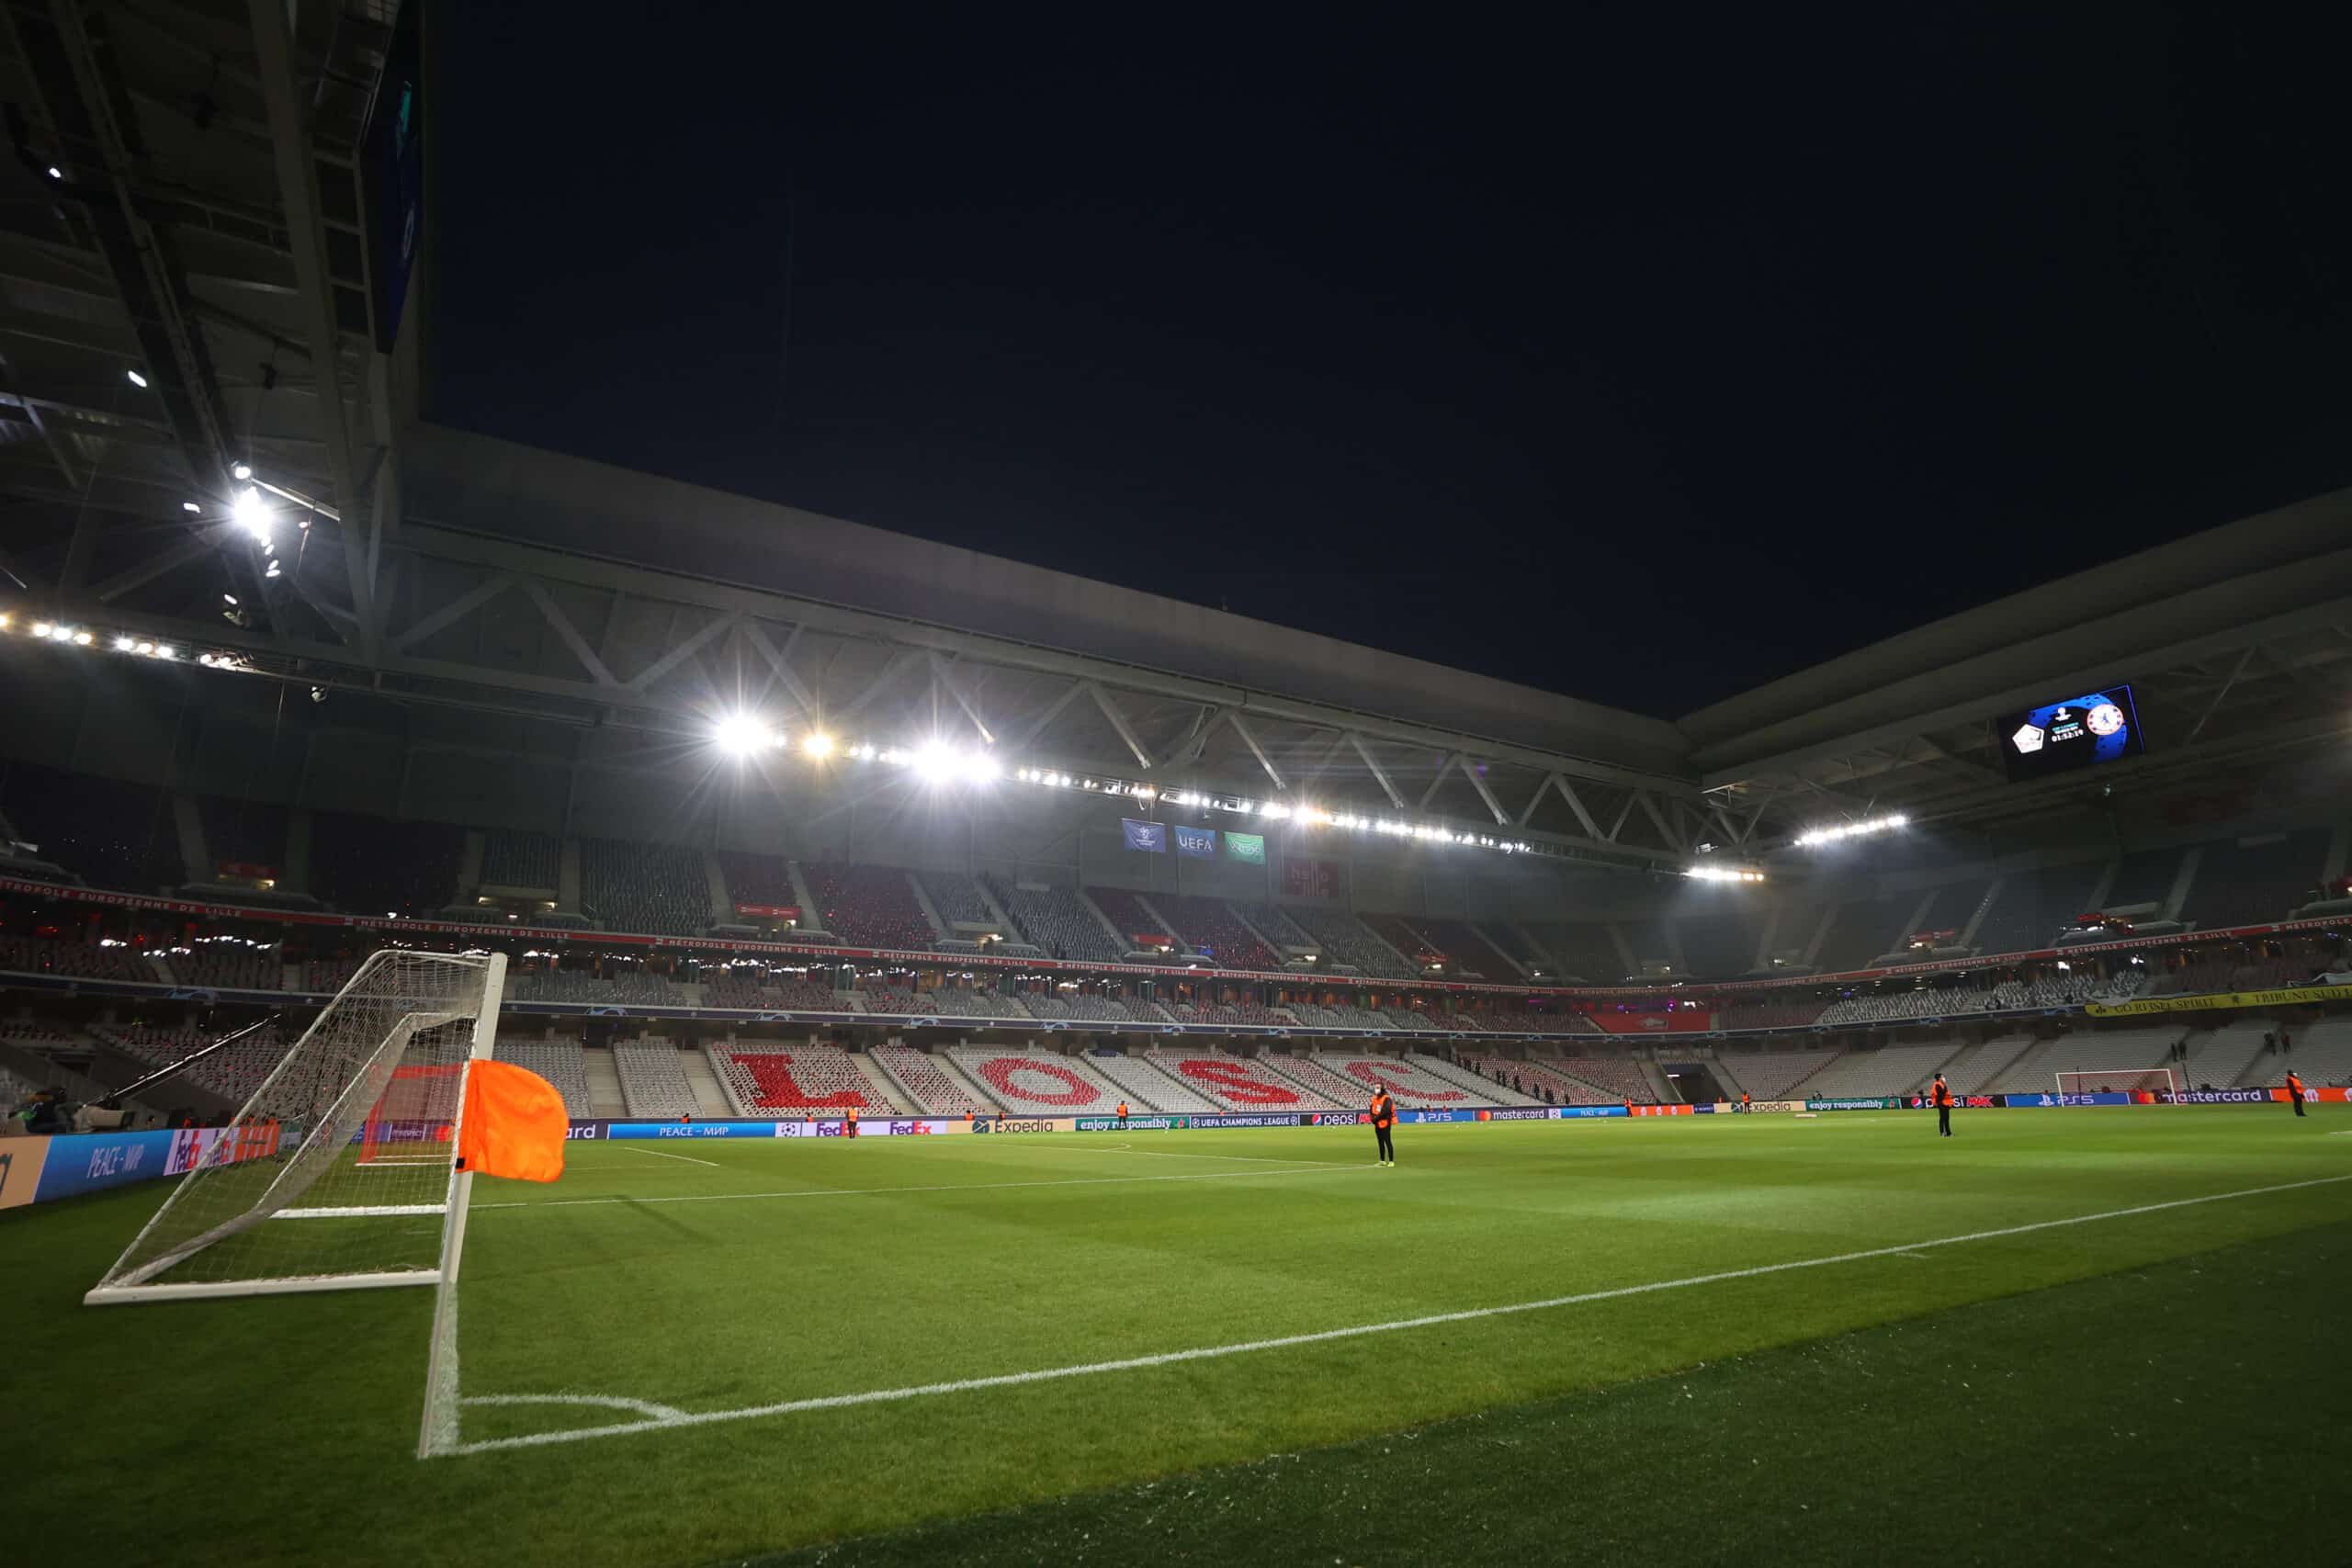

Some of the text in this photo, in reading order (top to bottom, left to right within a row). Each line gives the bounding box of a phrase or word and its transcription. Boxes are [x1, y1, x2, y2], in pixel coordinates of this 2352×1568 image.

[1179, 835, 1213, 852] UEFA
[2205, 931, 2232, 940] LILLE
[2255, 990, 2308, 1003] TRIBUNE
[2176, 998, 2213, 1008] SPIRIT
[1809, 1099, 1883, 1110] enjoy responsibly
[1966, 1096, 1994, 1108] MAX
[2057, 1095, 2094, 1104] PS5
[1324, 1112, 1357, 1125] pepsi
[1428, 1112, 1452, 1122] PS5
[1493, 1109, 1544, 1120] mastercard
[995, 1119, 1053, 1133] Expedia
[1080, 1119, 1110, 1131] enjoy
[1221, 1118, 1261, 1126] CHAMPIONS
[1263, 1117, 1289, 1125] LEAGUE
[660, 1126, 694, 1137] PEACE
[889, 1120, 932, 1135] FedEx
[86, 1146, 121, 1179] PEACE
